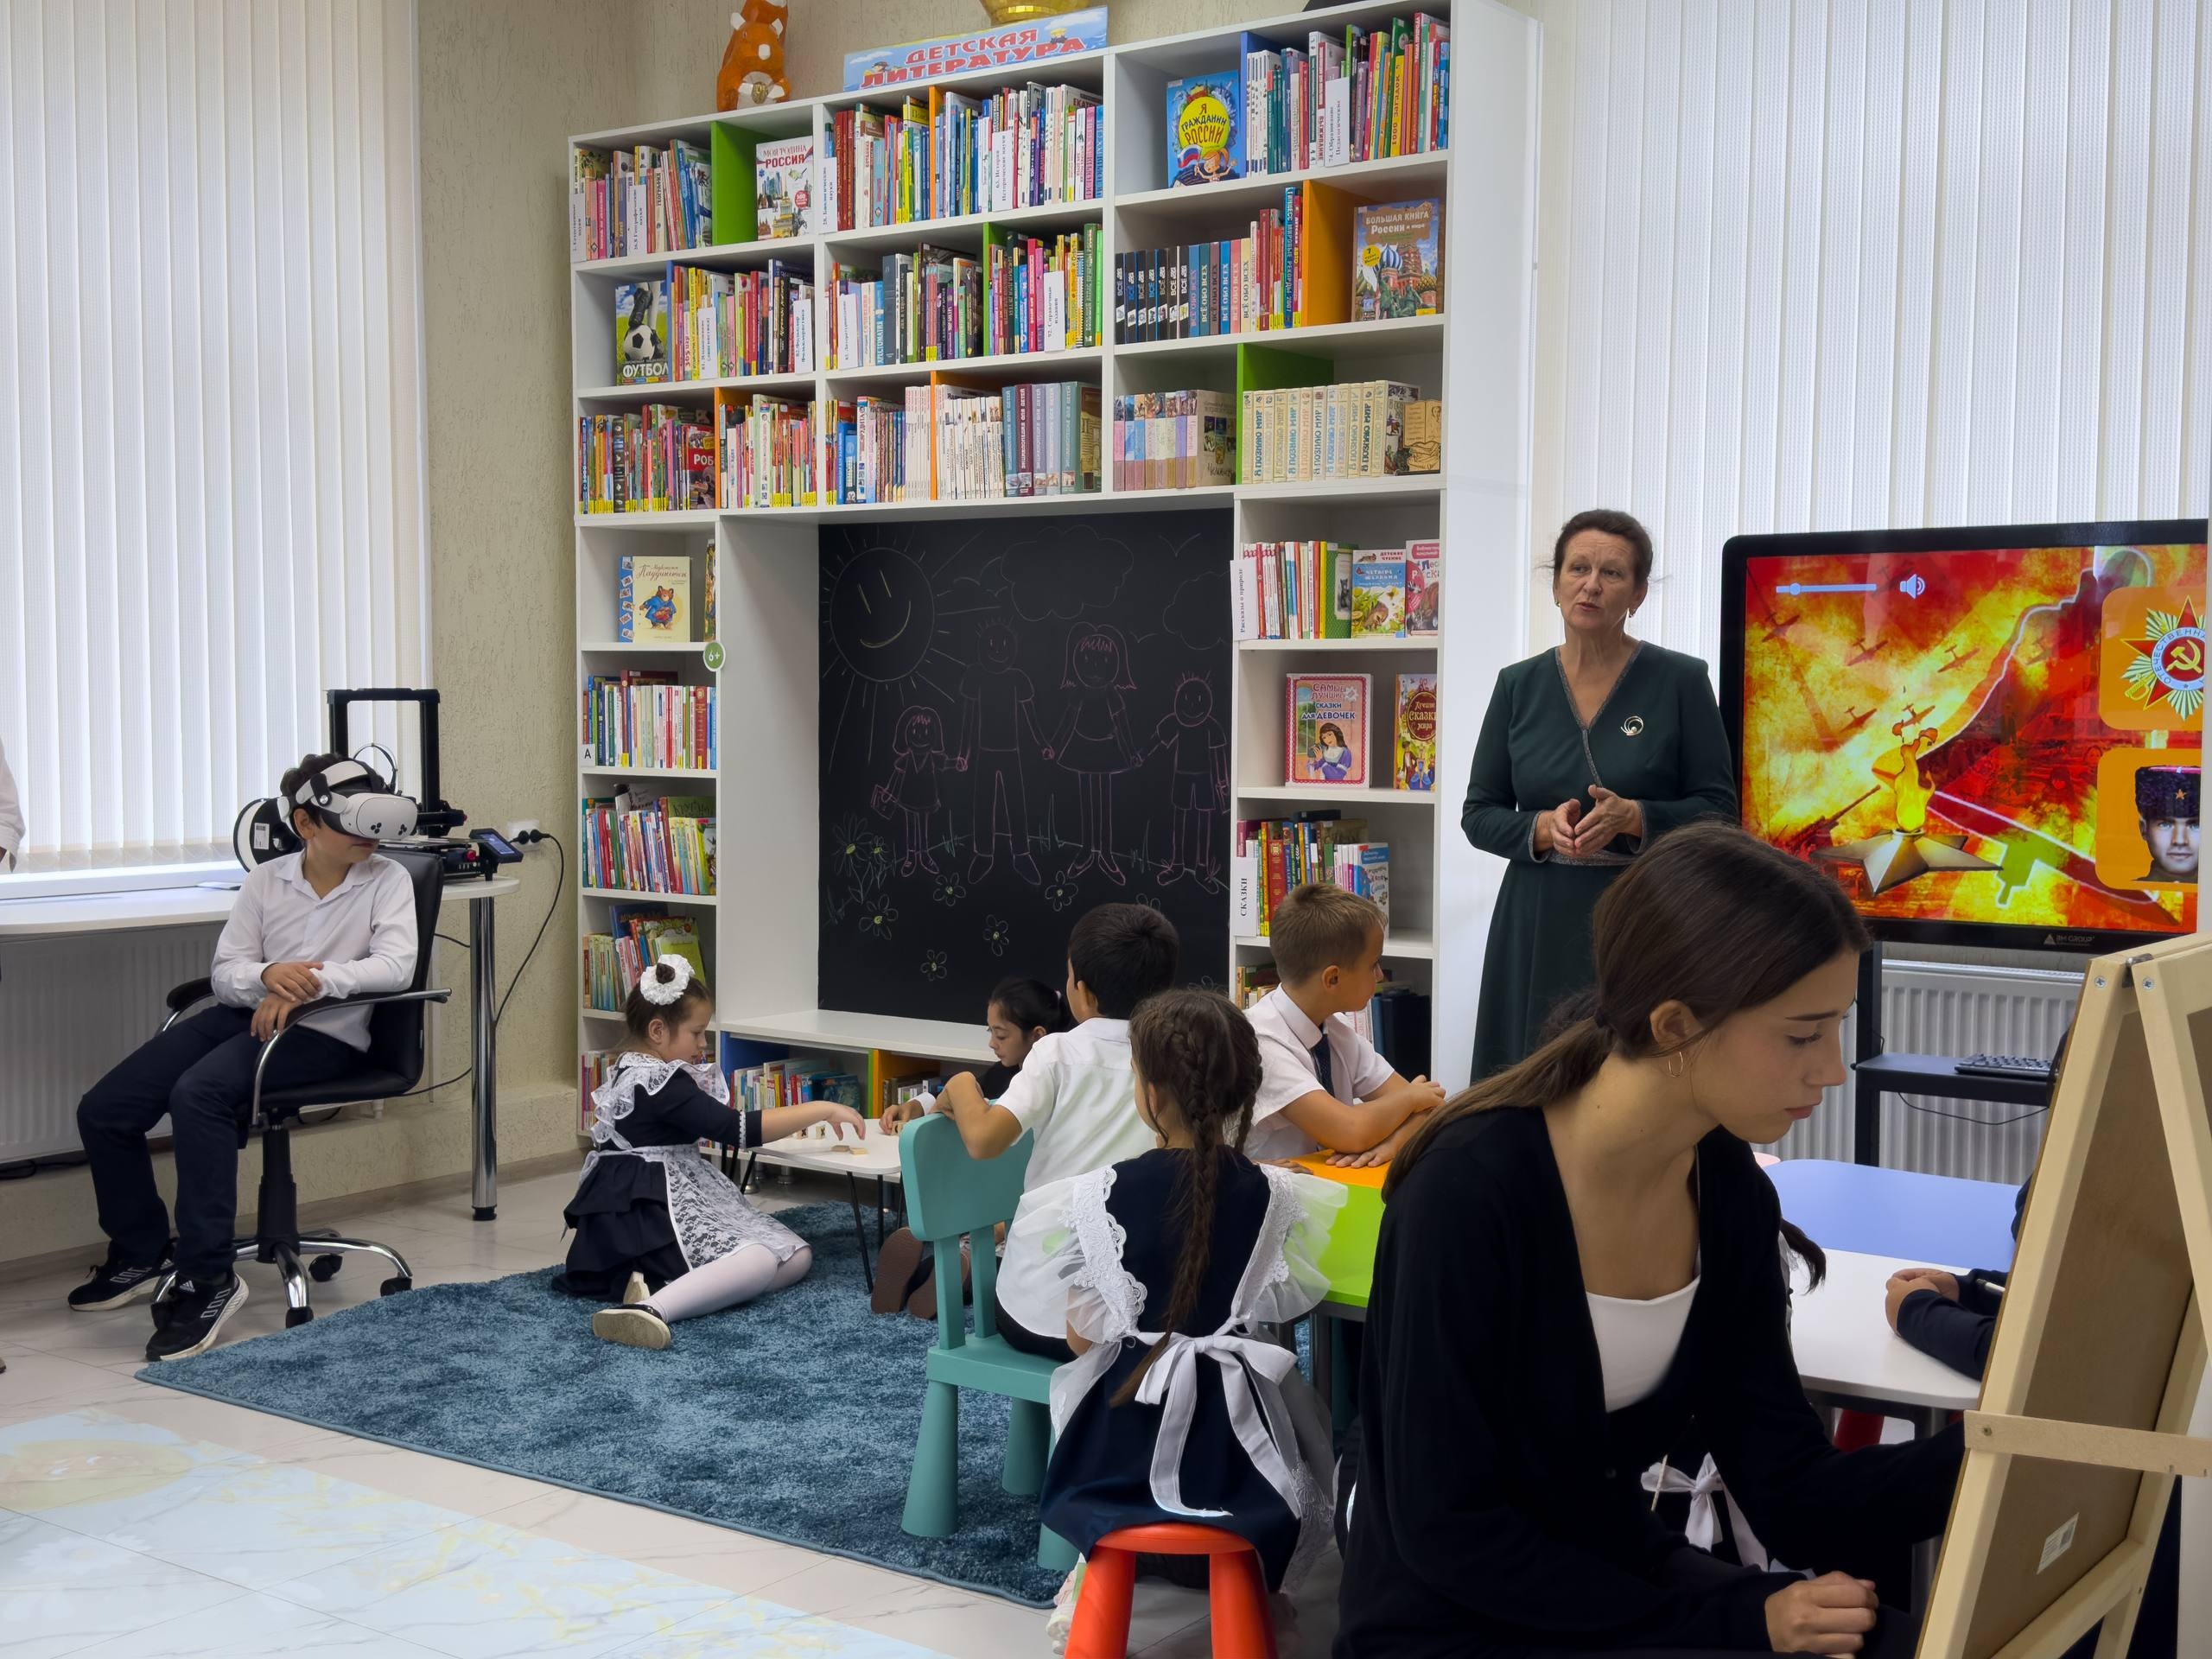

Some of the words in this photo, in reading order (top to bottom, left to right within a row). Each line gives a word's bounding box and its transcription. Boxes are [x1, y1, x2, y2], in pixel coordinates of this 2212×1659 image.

[906, 29, 1038, 65] ДЕТСКАЯ
[861, 37, 1085, 90] ЛИТЕРАТУРА
[1199, 104, 1207, 114] Я
[1182, 115, 1227, 132] ГРАЖДАНИН
[1185, 124, 1224, 145] РОССИИ
[779, 145, 806, 156] РОДИНА
[766, 154, 805, 168] РОССИЯ
[1366, 213, 1402, 225] БОЛЬШАЯ
[1405, 211, 1429, 220] КНИГА
[1371, 225, 1405, 234] России
[623, 363, 669, 378] ФУТБОЛ
[1327, 406, 1336, 425] МИР
[1313, 430, 1322, 466] ПОЗНАЮ
[1326, 428, 1335, 464] ПОЗНАЮ
[1361, 425, 1370, 462] ПОЗНАЮ
[709, 650, 720, 662] 6+
[584, 748, 591, 759] А
